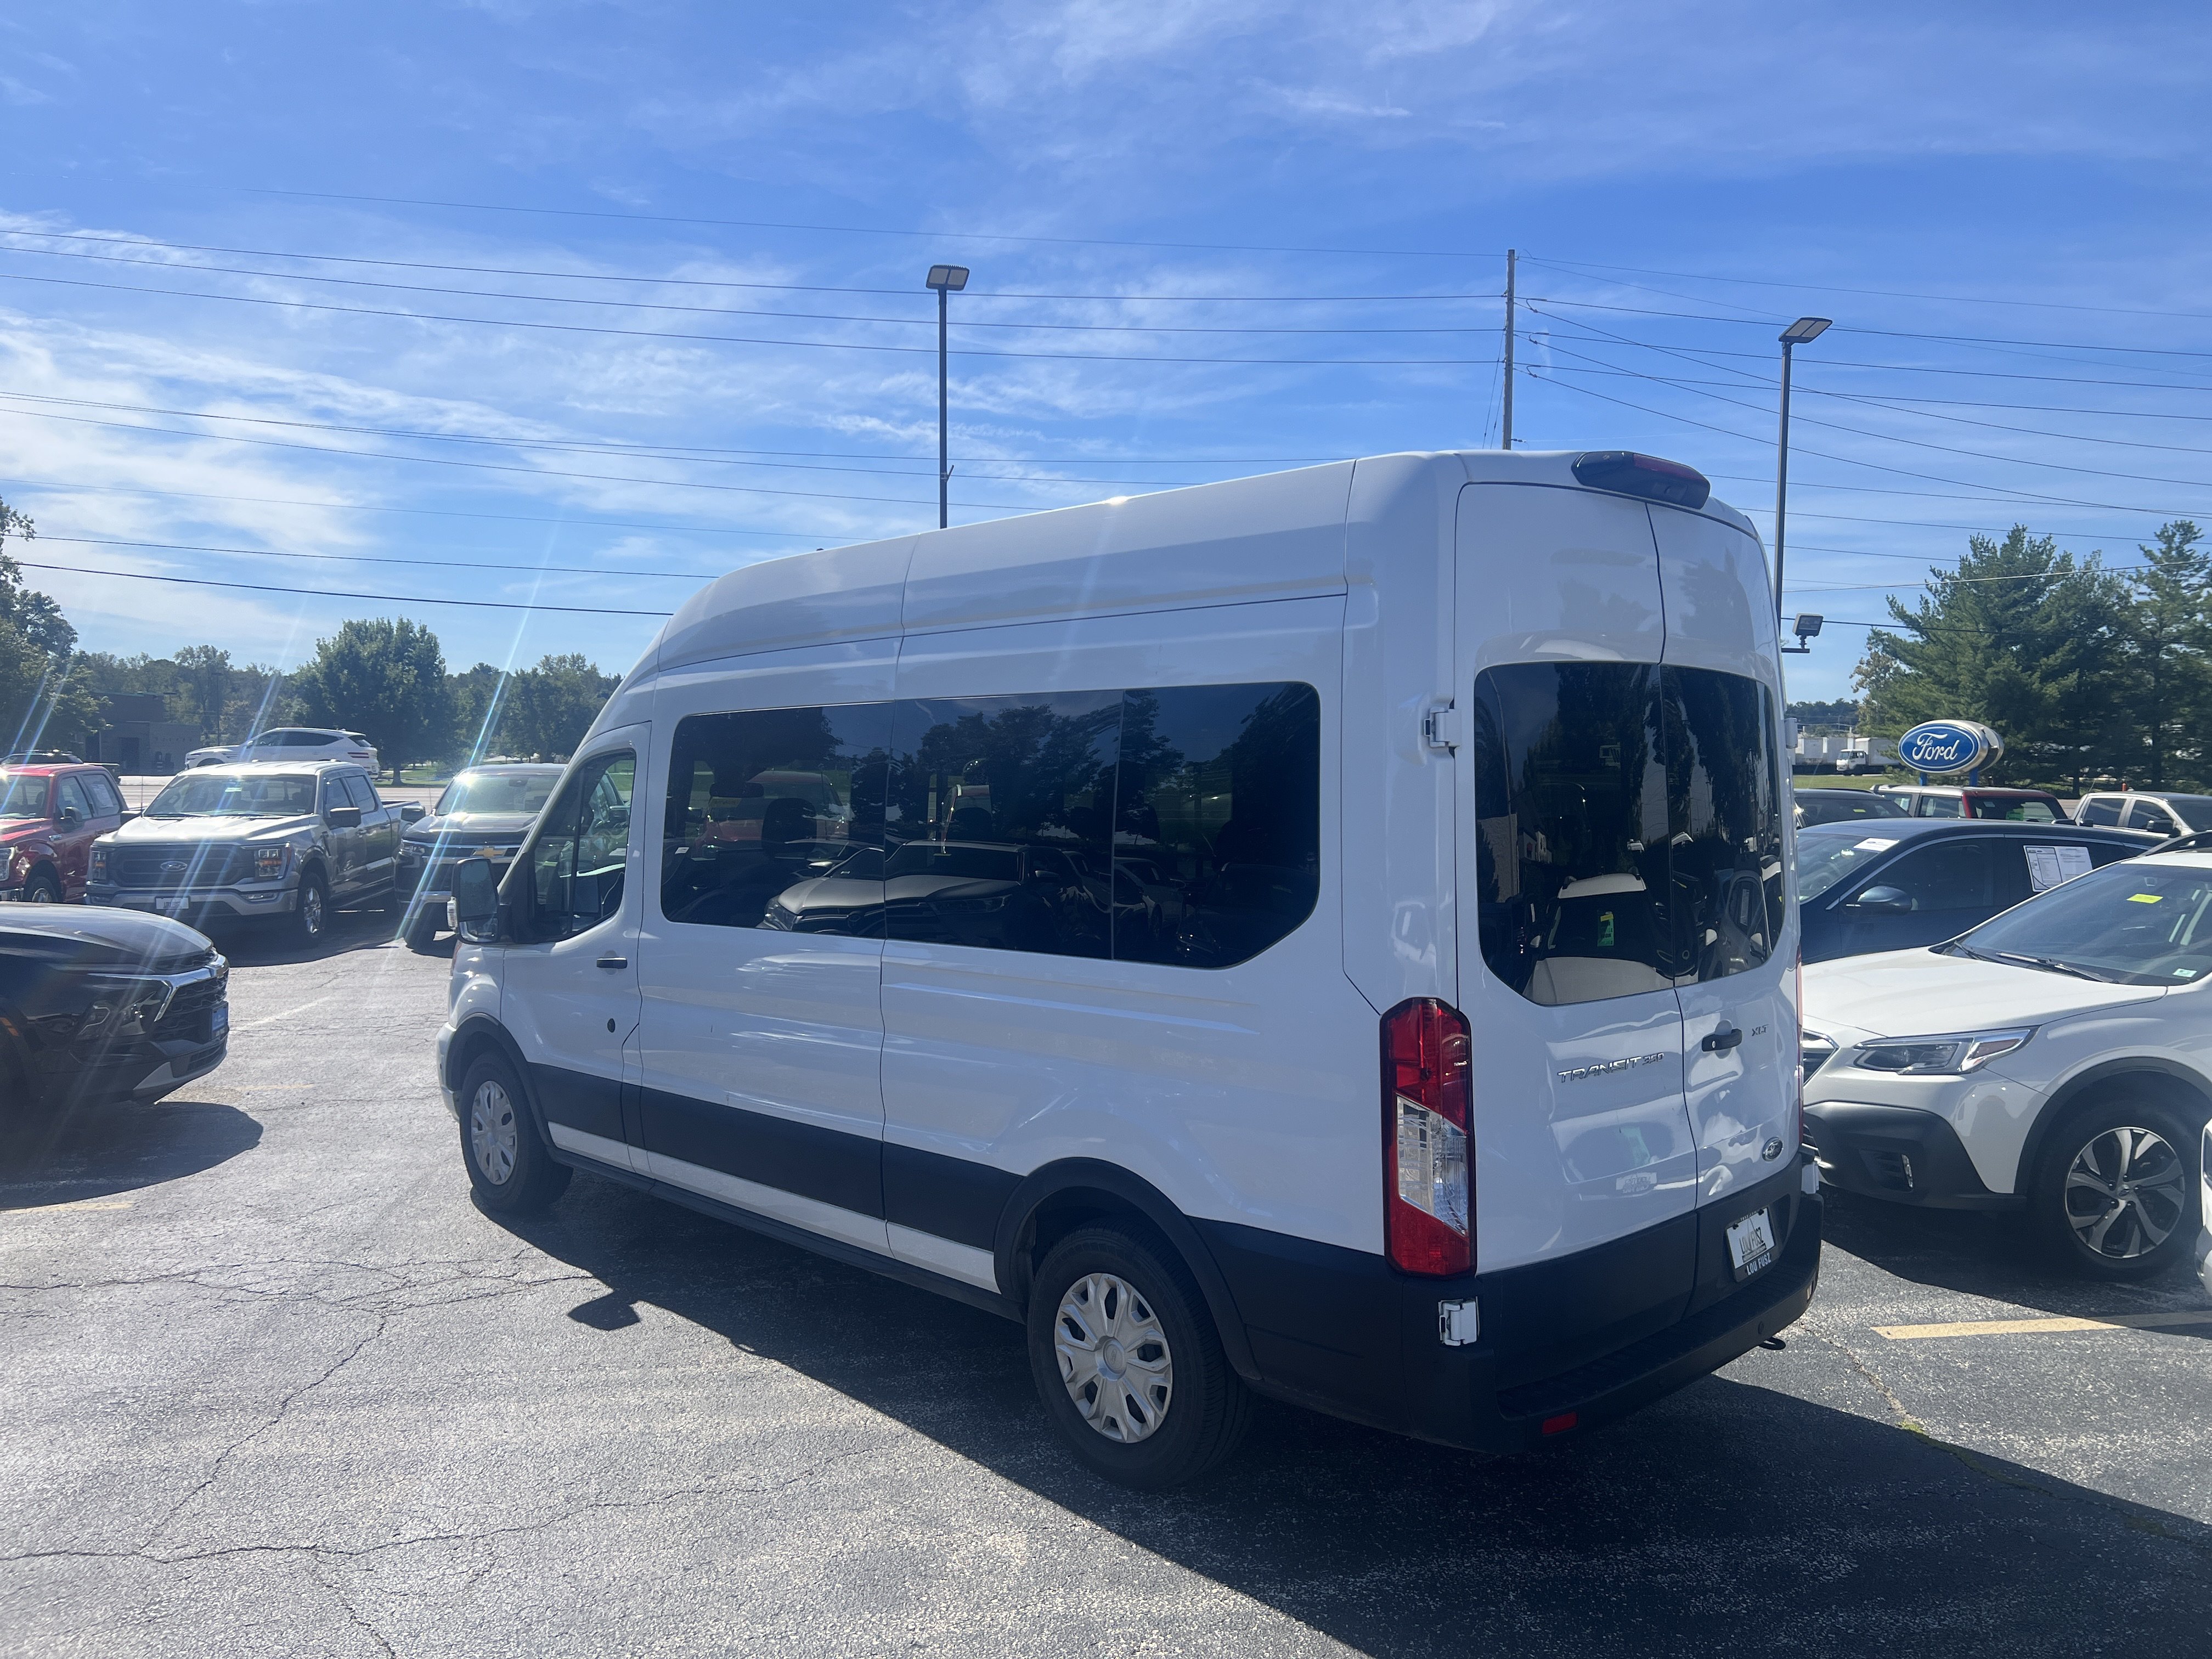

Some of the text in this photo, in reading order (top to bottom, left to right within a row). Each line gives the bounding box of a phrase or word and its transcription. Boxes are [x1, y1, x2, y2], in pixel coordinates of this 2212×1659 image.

[1912, 732, 1960, 760] Ford
[1752, 1024, 1769, 1036] XLT
[1557, 1052, 1664, 1083] TRANSIT 350
[1739, 1232, 1752, 1255] LOU
[1751, 1227, 1764, 1249] FUSZ
[1746, 1261, 1757, 1276] LOU
[1757, 1252, 1771, 1268] FUSZ
